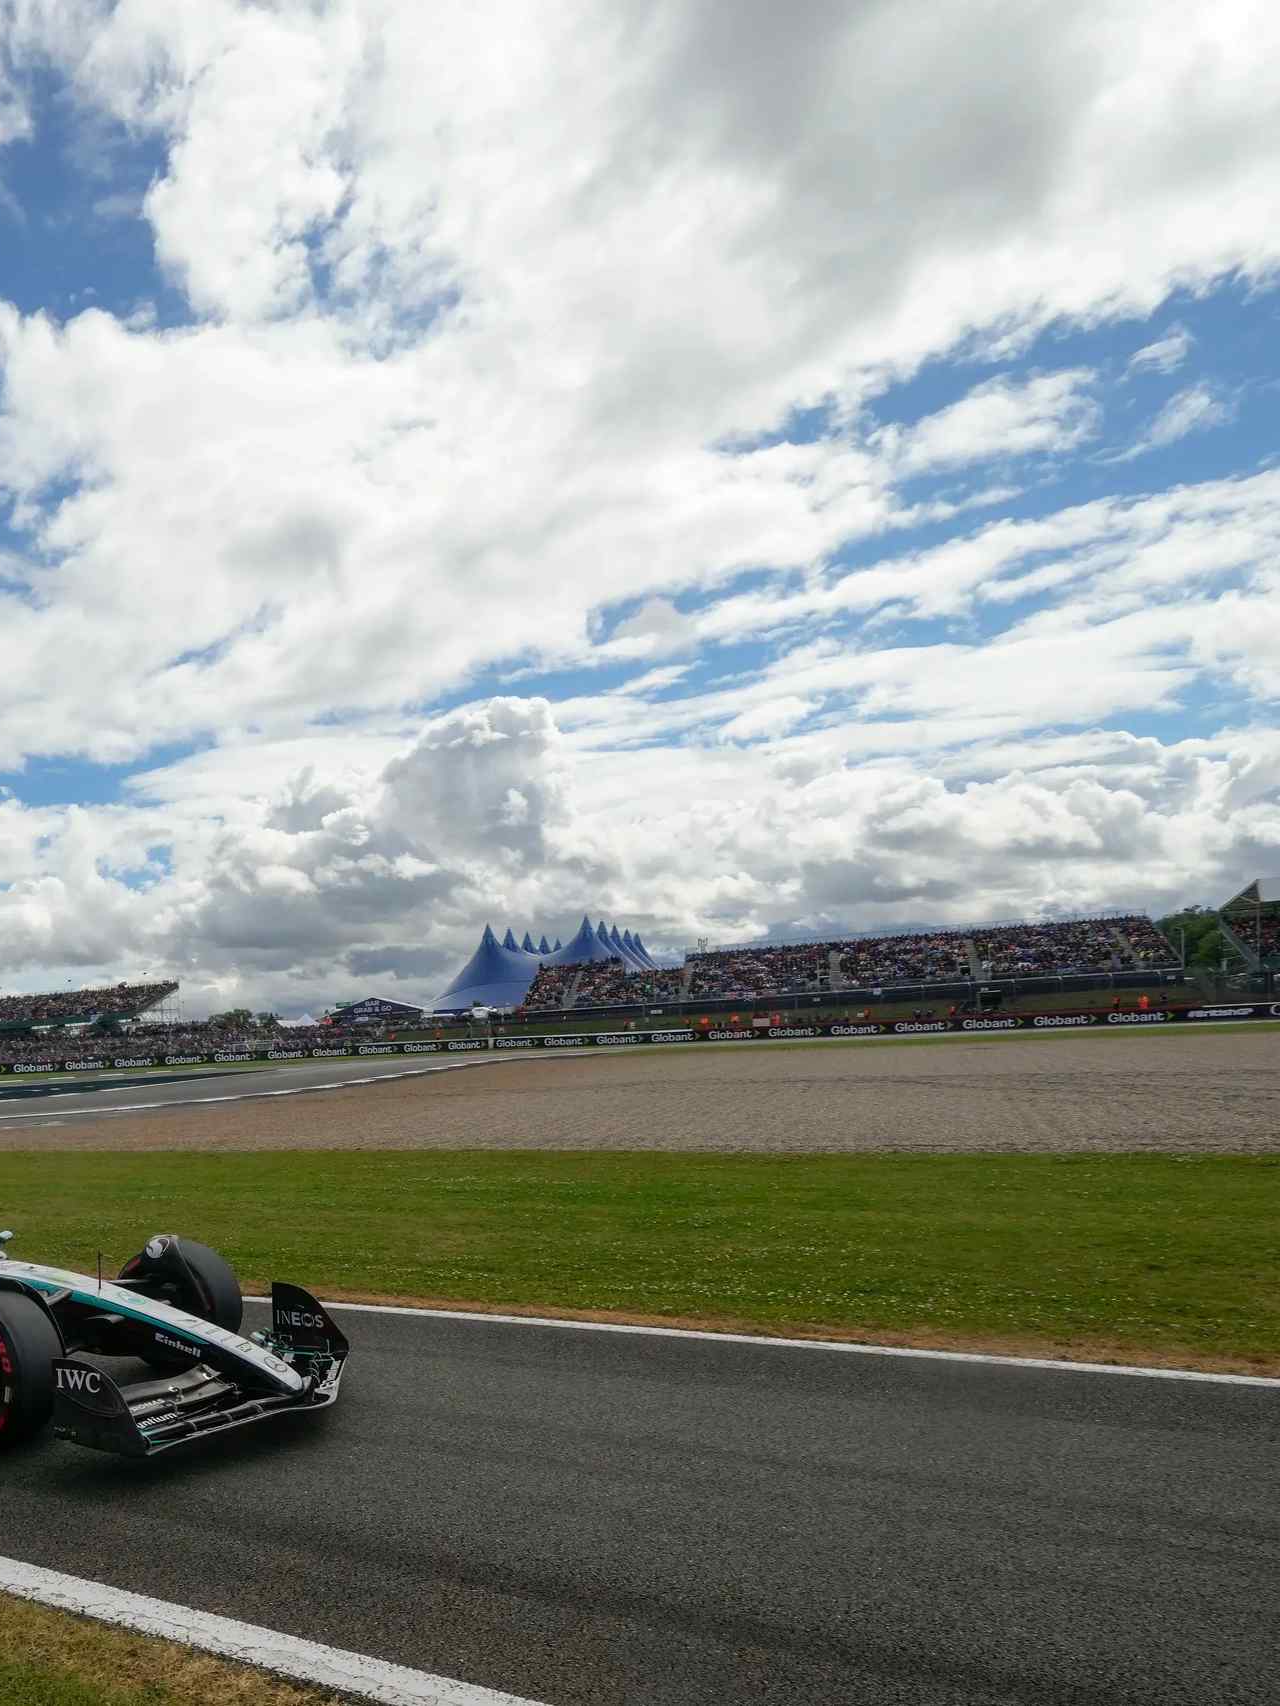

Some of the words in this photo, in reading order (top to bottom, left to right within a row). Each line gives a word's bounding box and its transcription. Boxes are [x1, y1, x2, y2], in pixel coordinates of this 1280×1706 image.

[1034, 1016, 1088, 1026] Globant
[1108, 1012, 1165, 1023] Globant
[895, 1022, 945, 1032] Globant
[963, 1019, 1015, 1029] Globant
[708, 1030, 752, 1040] Globant
[768, 1027, 814, 1037] Globant
[831, 1025, 878, 1035] Globant
[544, 1037, 583, 1046] Globant
[596, 1035, 637, 1045] Globant
[651, 1032, 694, 1042] Globant
[404, 1043, 436, 1052] Globant
[448, 1041, 480, 1050] Globant
[496, 1039, 532, 1048] Globant
[267, 1050, 303, 1060] Globant
[312, 1048, 347, 1057] Globant
[359, 1046, 393, 1055] Globant
[165, 1055, 202, 1065] Globant
[214, 1052, 251, 1062] Globant
[13, 1063, 54, 1073] Globant
[65, 1060, 104, 1070] Globant
[114, 1058, 152, 1068] Globant
[276, 1309, 325, 1328] INEOS
[154, 1332, 201, 1358] Einhell
[56, 1368, 101, 1393] IWC
